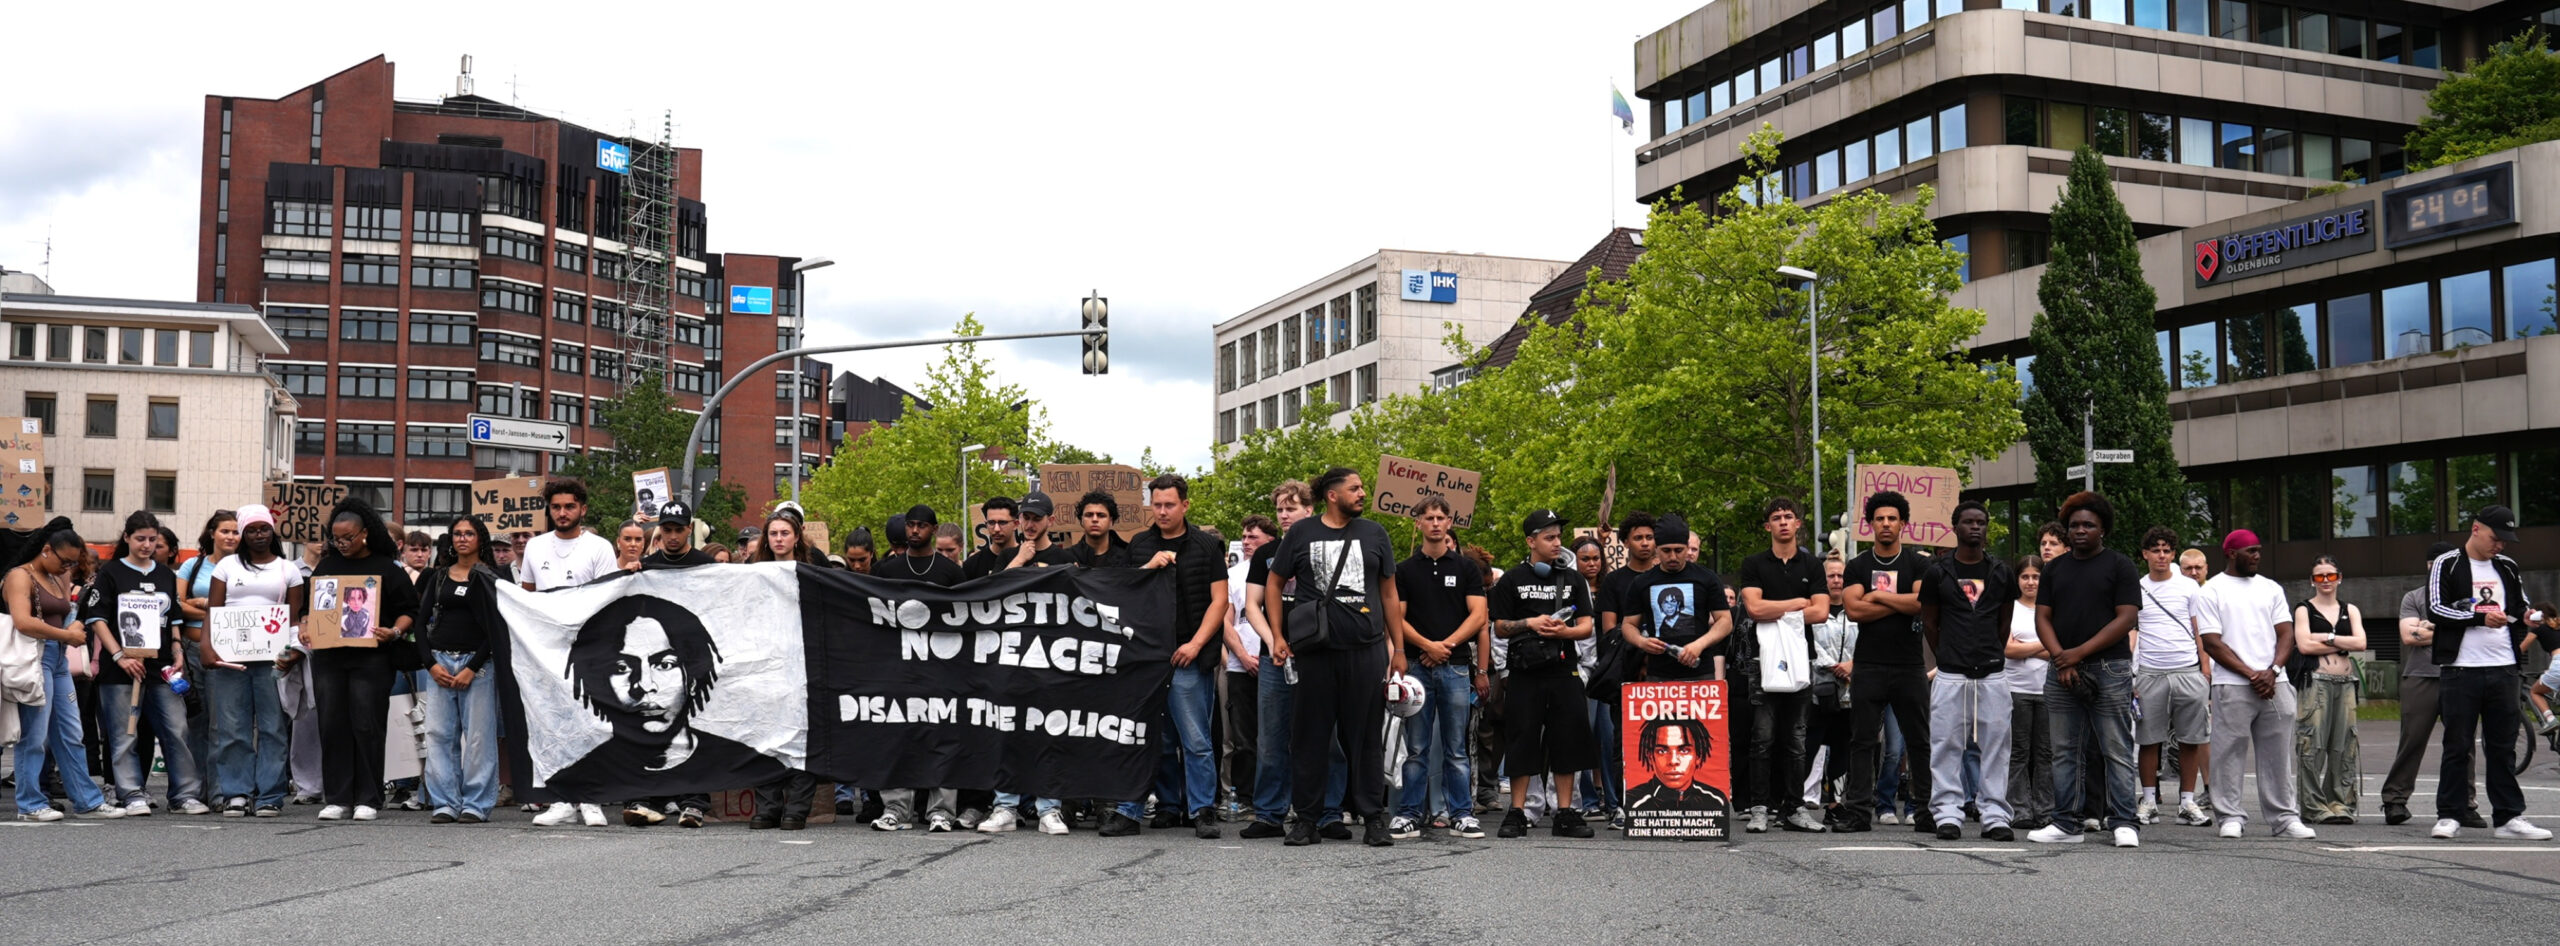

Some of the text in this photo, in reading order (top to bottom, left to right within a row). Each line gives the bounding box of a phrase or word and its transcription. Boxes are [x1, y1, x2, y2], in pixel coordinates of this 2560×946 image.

[2410, 193, 2445, 230] 24
[2223, 208, 2365, 262] ÖFFENTLICHE
[2226, 255, 2281, 274] OLDENBURG
[1433, 275, 1456, 289] IHK
[0, 433, 41, 450] ustice
[478, 426, 551, 440] P Horst-Janssen-Museum
[2095, 451, 2131, 461] Staugraben
[1047, 470, 1141, 493] KEIN FREUND
[1388, 460, 1473, 493] Keine Ruhe
[1865, 471, 1942, 497] AGAINST
[0, 487, 42, 508] orenz!
[272, 484, 344, 506] JUSTICE
[474, 489, 545, 512] WE BLEED
[289, 506, 320, 522] FOR
[1378, 492, 1472, 526] Gerekeit
[281, 520, 334, 542] OREN
[496, 513, 533, 530] SAME
[1859, 517, 1953, 543] BALITY
[1607, 545, 1624, 557] OR
[1530, 591, 1549, 599] COUGH
[128, 602, 158, 610] Lorenz
[213, 613, 220, 629] 4
[868, 592, 1134, 640] NO JUSTICE,
[213, 631, 234, 646] Kein
[901, 629, 1121, 675] NO PEACE!
[1628, 685, 1719, 699] JUSTICE FOR
[1628, 700, 1722, 720] LORENZ
[838, 695, 1147, 745] DISARM THE POLICE!
[1633, 818, 1716, 828] SIE HATTEN MACHT,
[1658, 809, 1685, 818] TRÄUME,
[1628, 828, 1724, 836] KEINE MENSCHLICHKEIT.
